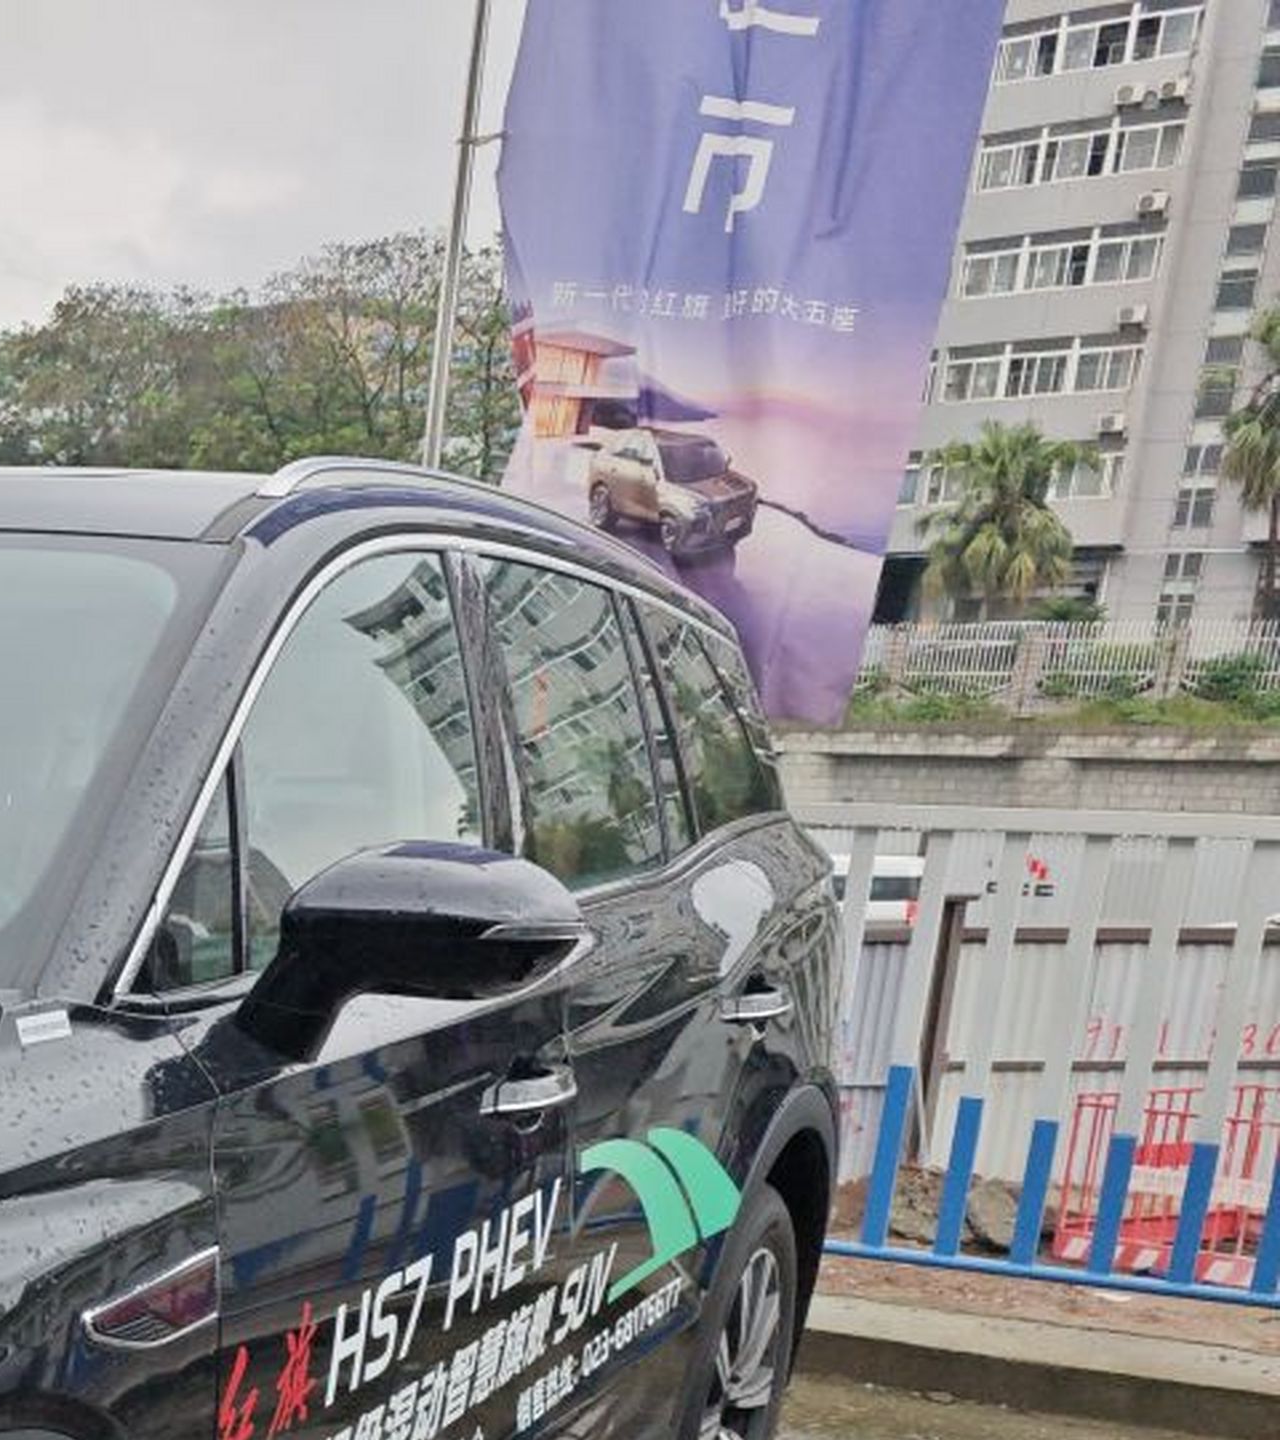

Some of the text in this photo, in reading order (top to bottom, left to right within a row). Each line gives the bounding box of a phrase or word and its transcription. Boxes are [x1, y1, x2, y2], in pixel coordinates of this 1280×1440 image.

[324, 1253, 433, 1408] HS7
[443, 1176, 562, 1332] PHEV
[552, 1241, 618, 1345] SUV
